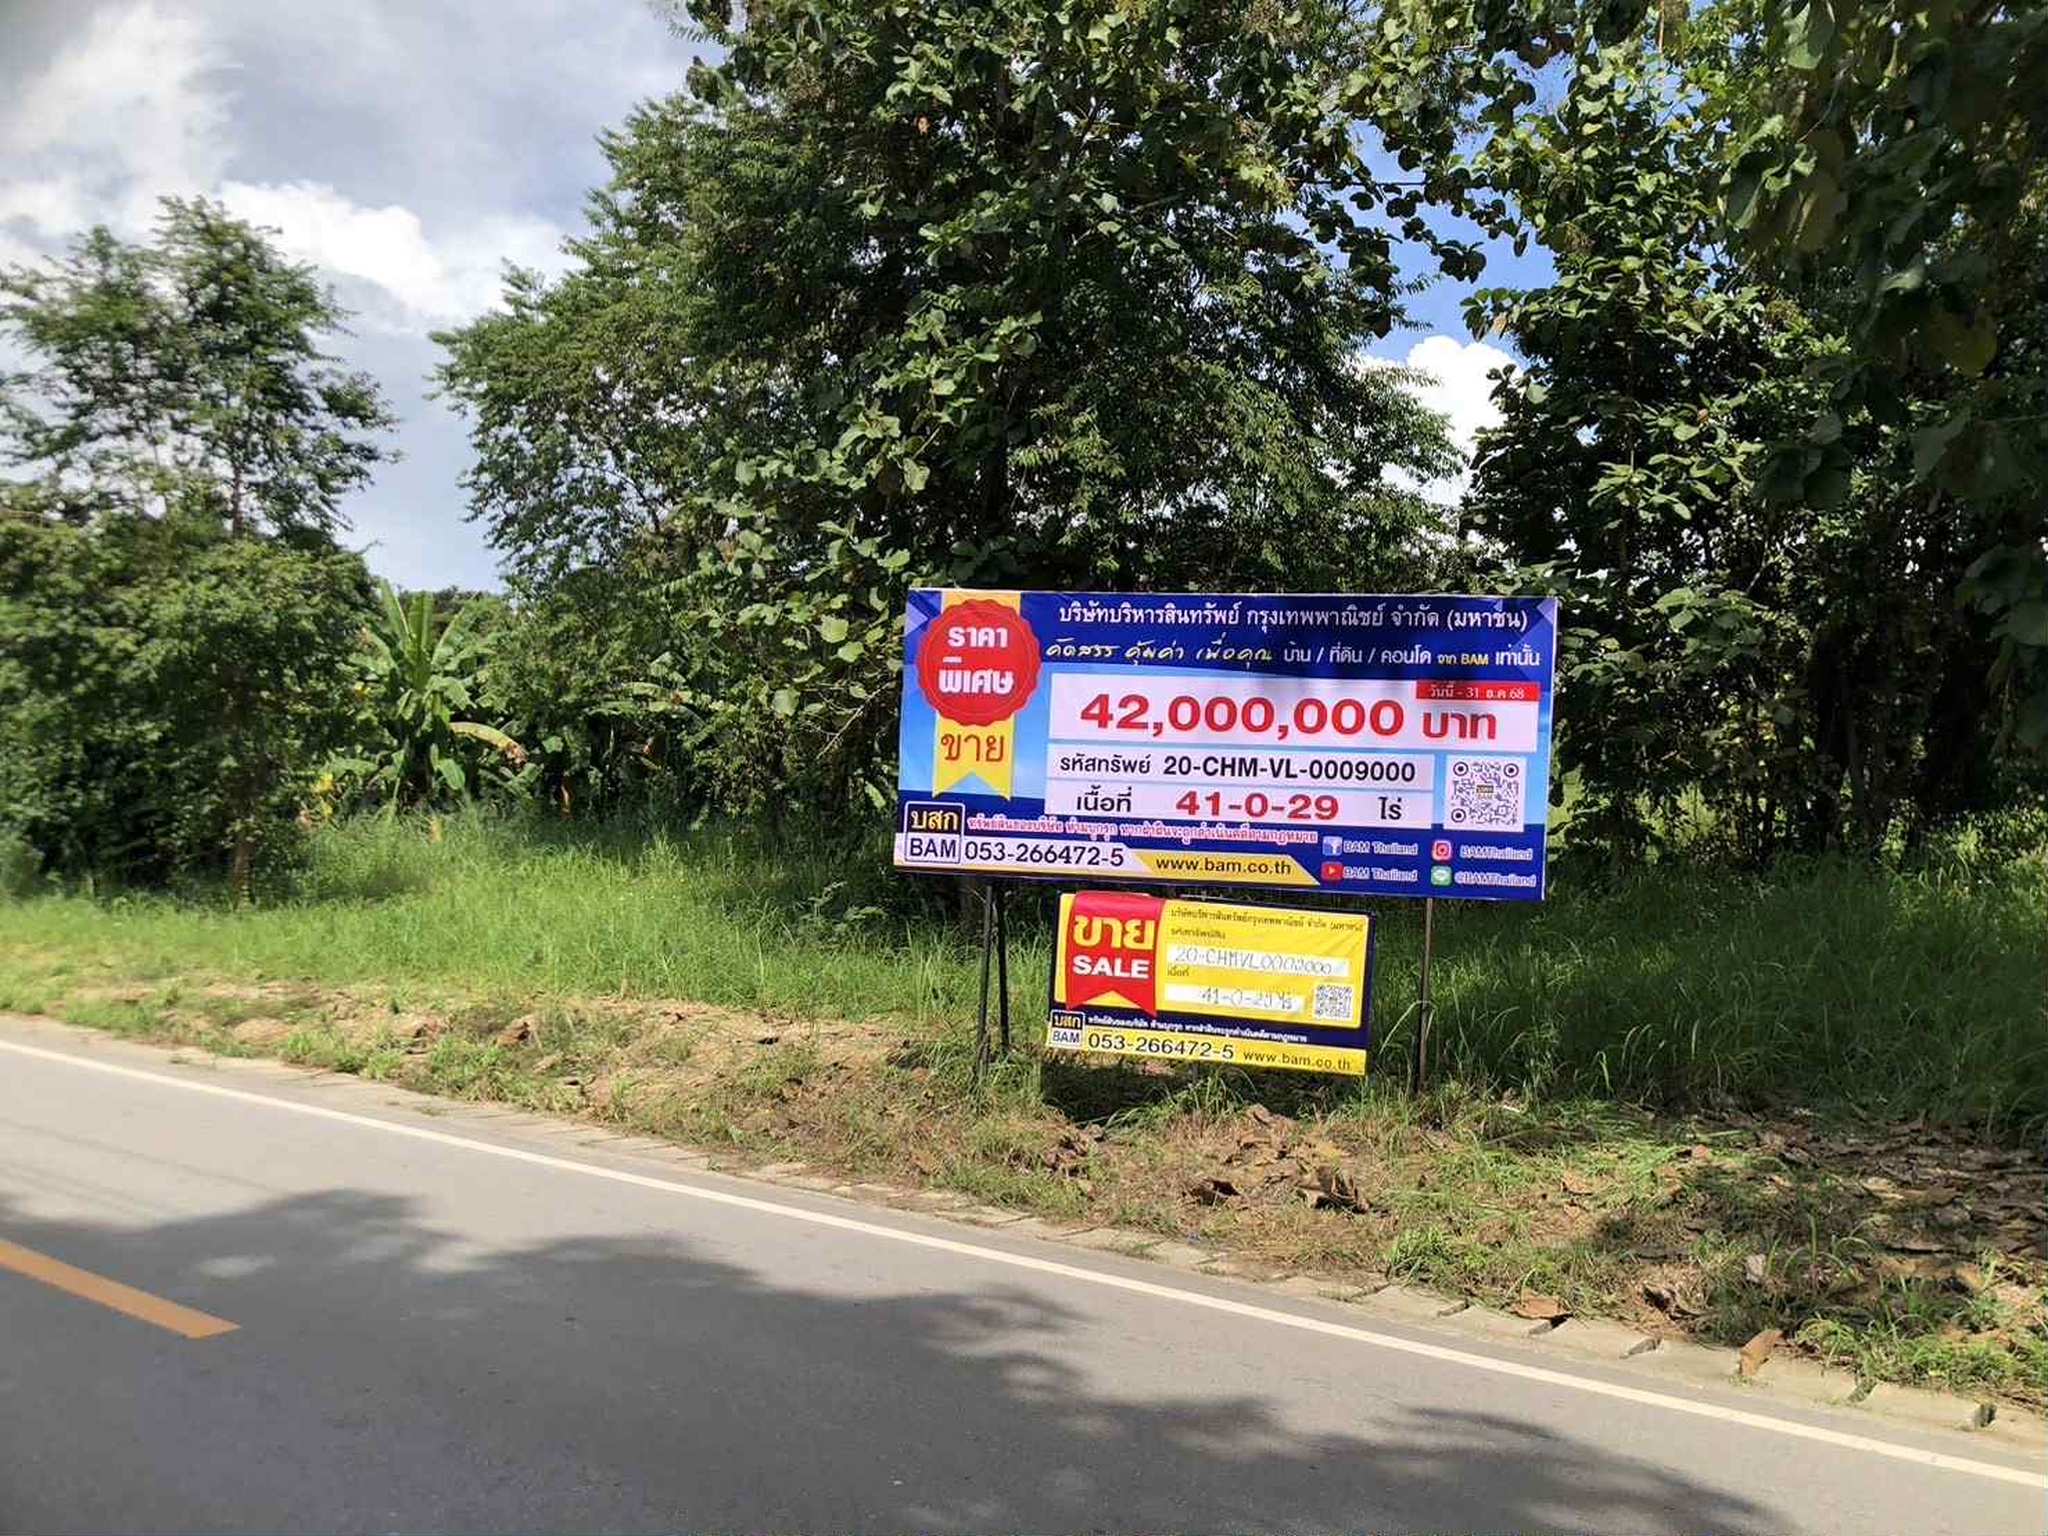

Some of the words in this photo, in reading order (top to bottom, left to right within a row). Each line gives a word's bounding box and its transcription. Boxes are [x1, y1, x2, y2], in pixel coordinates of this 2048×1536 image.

[1059, 601, 1240, 625] บริษัทบริหารสินทรัพย์
[1247, 602, 1384, 632] กรุงเทพพาณิชย์
[1390, 605, 1439, 627] จำกัด
[949, 626, 1008, 648] ราคา
[1283, 641, 1311, 663] บ้าน
[1329, 642, 1362, 664] ที่ดิน
[1380, 645, 1431, 665] คอนโด
[1461, 653, 1489, 666] BAM
[1495, 644, 1540, 667] เท่านั้น
[938, 656, 1013, 694] พิเศษ
[1465, 687, 1479, 699] 31
[1080, 693, 1404, 740] 42,000,000
[1422, 711, 1497, 739] บาท
[940, 733, 1004, 761] ขาย
[1060, 753, 1151, 774] รหัสทรัพย์
[1163, 755, 1416, 783] 20-CHM-VL-0009000
[1076, 783, 1131, 814] เนื้อที่
[1175, 790, 1339, 821] 41-0-29
[1378, 796, 1403, 820] ไร่
[909, 808, 958, 830] บสก
[909, 838, 956, 859] BAM
[965, 841, 1124, 867] 053-266472-5
[1343, 840, 1370, 854] BAM
[1156, 858, 1291, 875] www.bam.co.th
[1074, 915, 1155, 949] ขาย
[1073, 955, 1149, 979] SALE
[1088, 1033, 1234, 1060] 053-266472-5
[1243, 1050, 1350, 1070] www.bam.co.th
